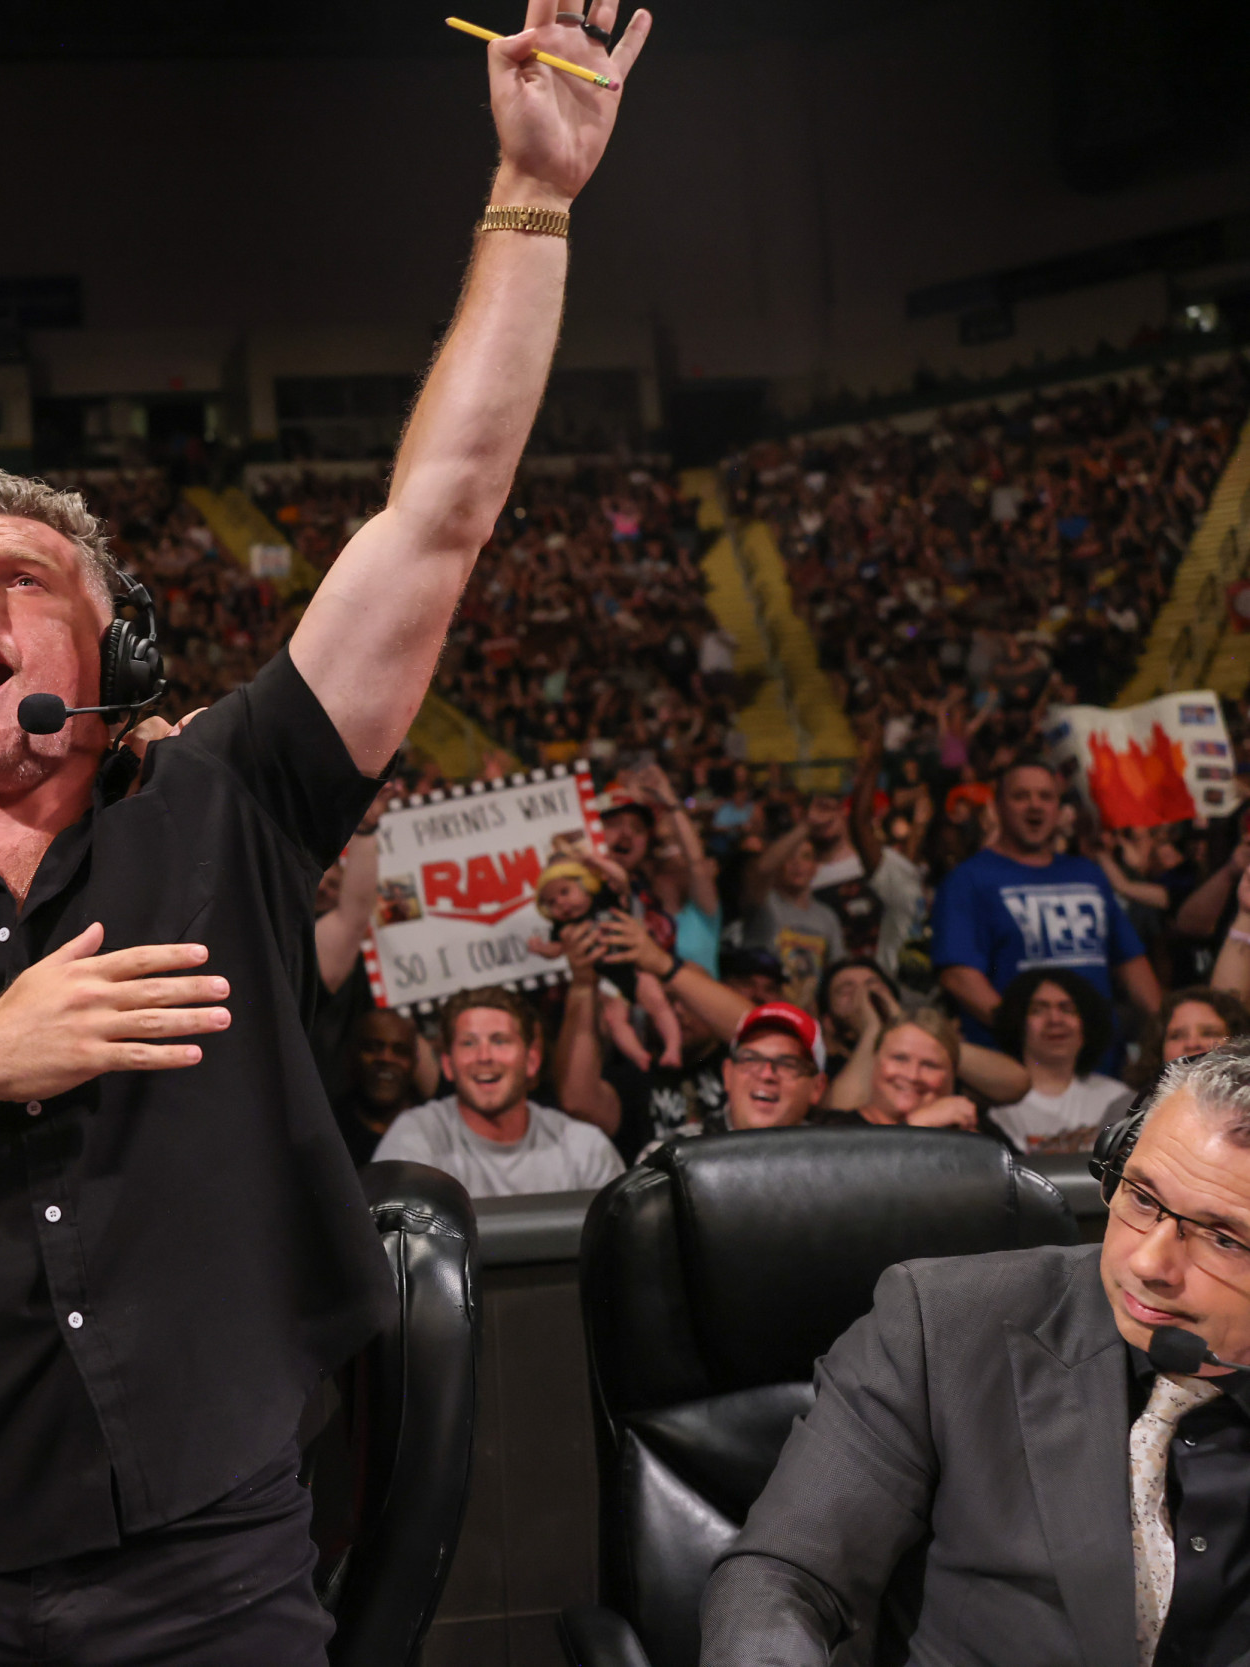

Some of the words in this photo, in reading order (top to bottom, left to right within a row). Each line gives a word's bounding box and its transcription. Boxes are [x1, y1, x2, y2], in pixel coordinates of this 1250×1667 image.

[413, 802, 507, 847] PARENTS
[421, 846, 541, 913] RAW
[393, 951, 428, 989] SO
[437, 945, 452, 979] I
